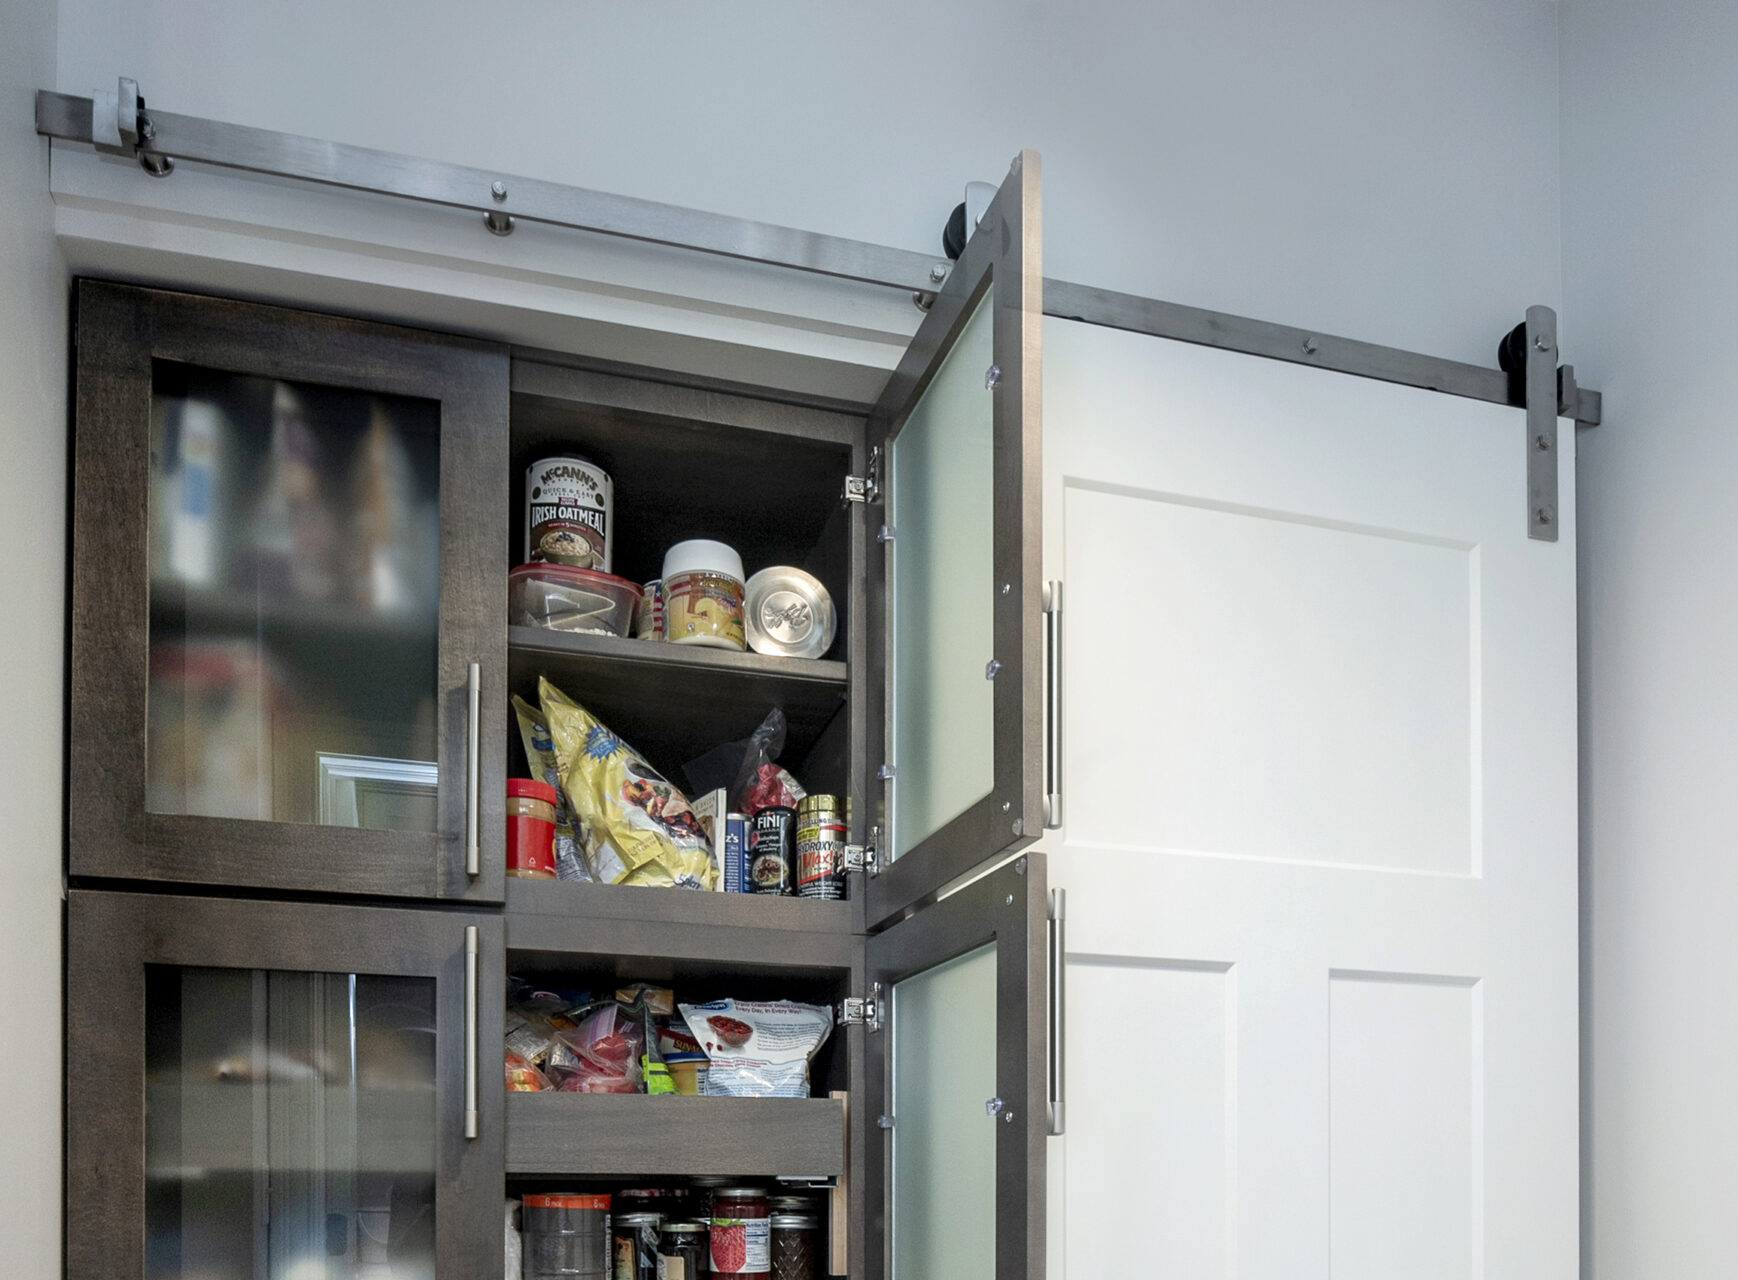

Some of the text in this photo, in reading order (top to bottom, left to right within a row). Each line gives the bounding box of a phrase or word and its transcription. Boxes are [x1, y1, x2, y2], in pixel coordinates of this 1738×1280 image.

[532, 506, 605, 537] IRISH OATMEAL
[757, 813, 780, 829] FINI
